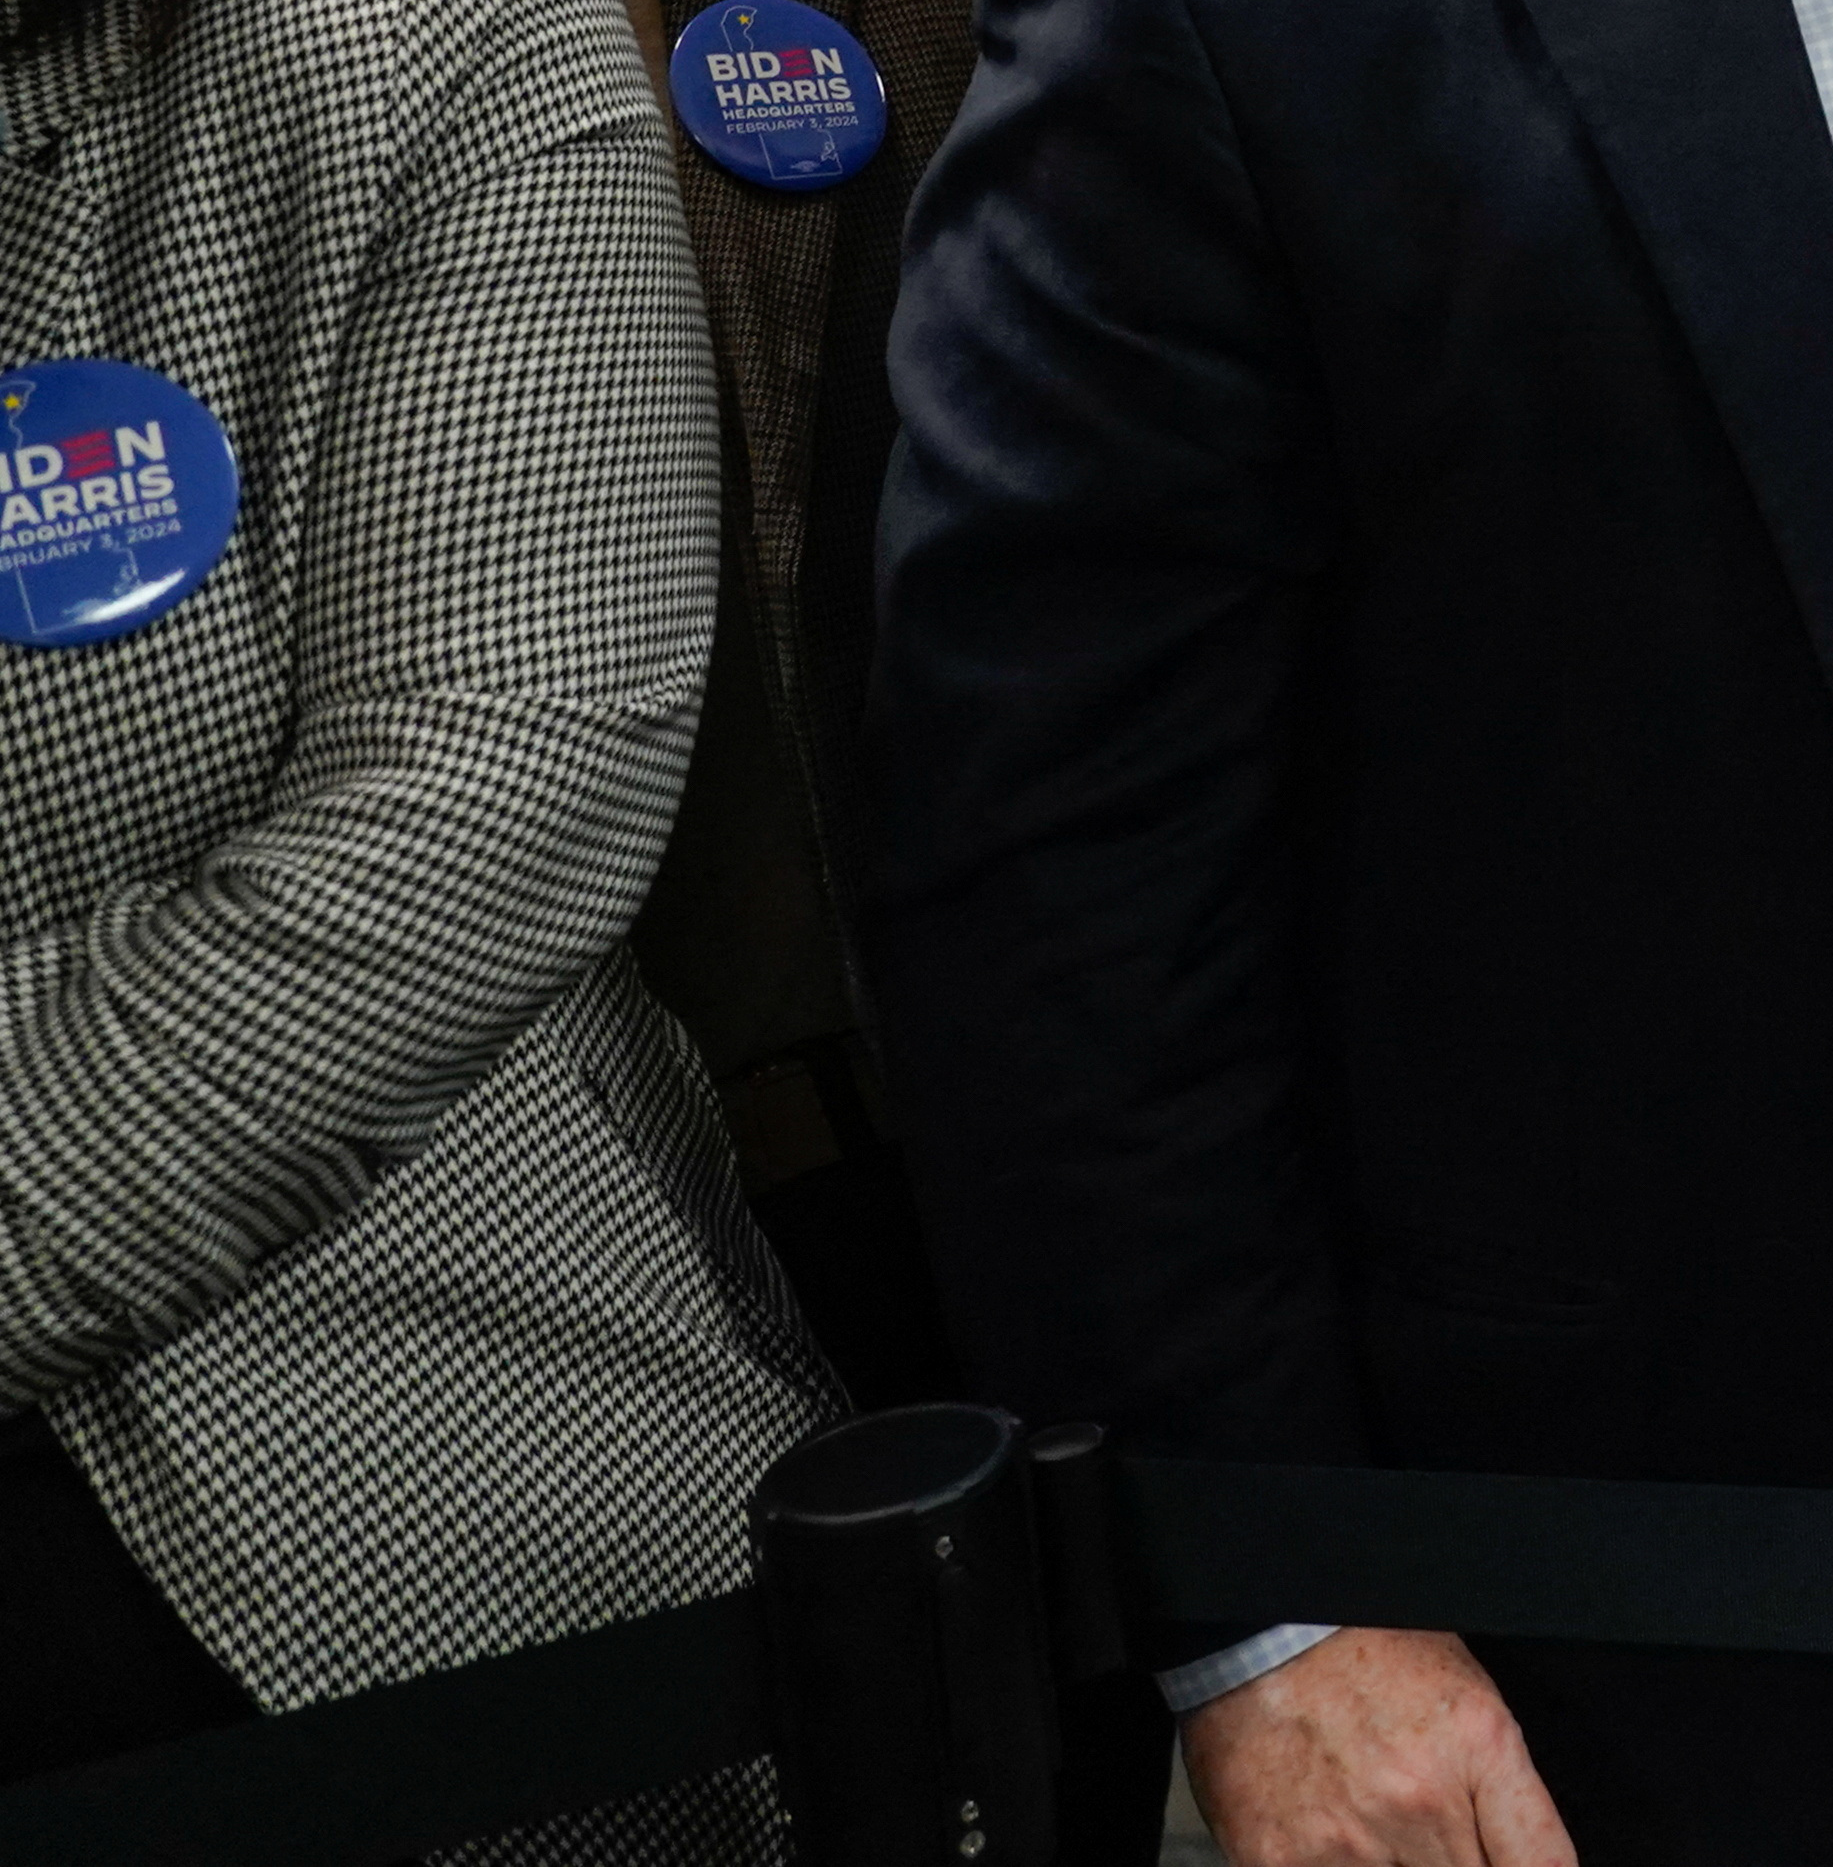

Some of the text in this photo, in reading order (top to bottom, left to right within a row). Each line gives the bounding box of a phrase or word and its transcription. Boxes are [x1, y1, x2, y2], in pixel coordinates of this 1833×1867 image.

[706, 48, 844, 82] BIDEN
[715, 77, 852, 108] HARRIS
[722, 101, 856, 121] HEADQUARTERS
[726, 115, 859, 135] FEBRUARY 3, 2024
[0, 421, 166, 494] IDEN
[0, 464, 175, 531] ARRIS
[0, 498, 179, 551] ADQUARTERS
[0, 537, 93, 572] BRUARY
[126, 518, 182, 544] 2024
